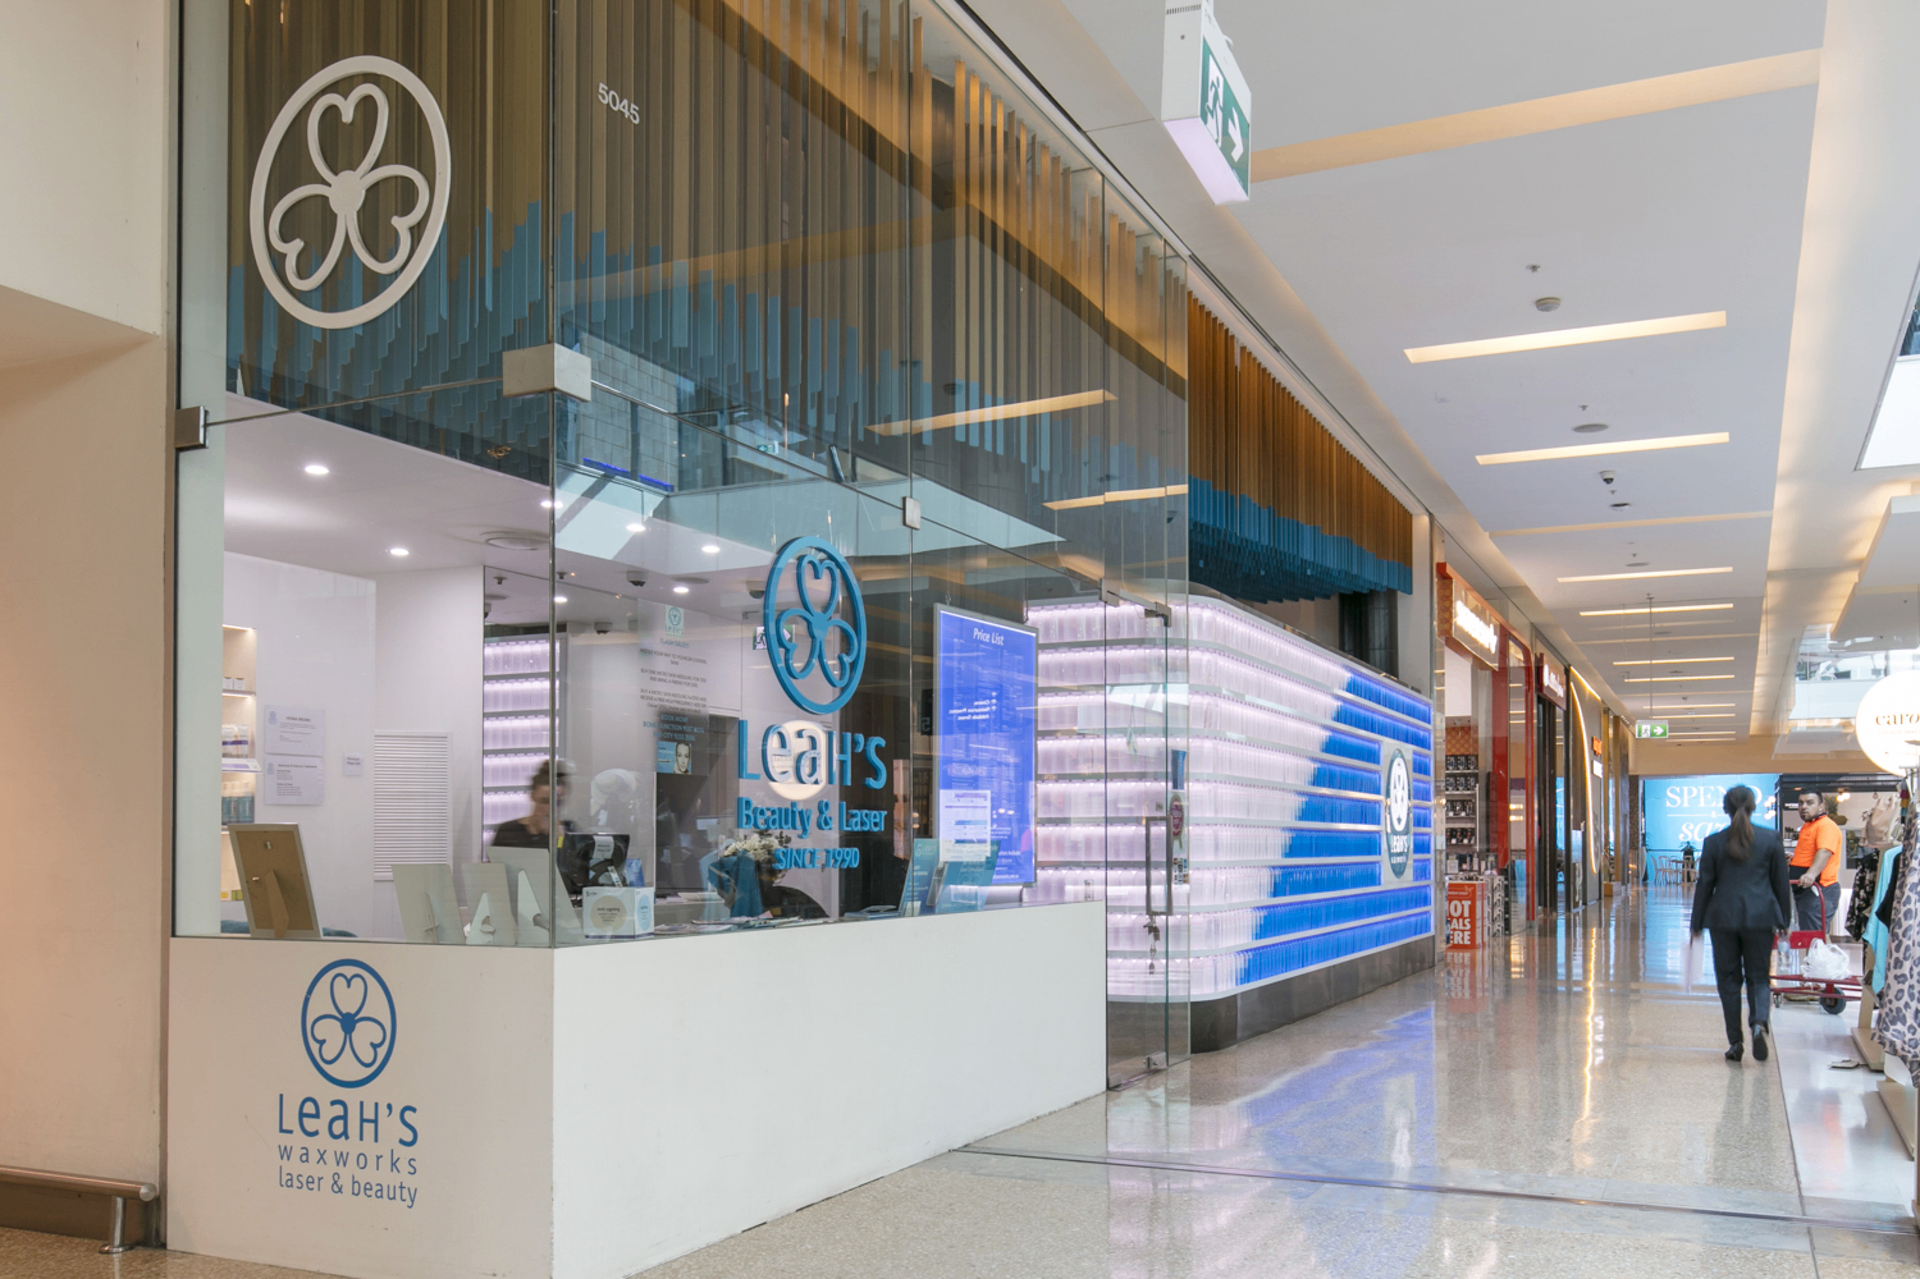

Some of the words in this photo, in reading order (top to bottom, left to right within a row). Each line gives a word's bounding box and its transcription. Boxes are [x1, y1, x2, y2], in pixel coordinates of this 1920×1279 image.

[598, 82, 640, 124] 5045
[973, 628, 990, 643] Price
[992, 632, 1004, 646] List
[737, 797, 813, 839] Beauty
[817, 799, 833, 831] &
[839, 801, 888, 832] Laser
[772, 847, 822, 870] SINCE
[824, 847, 860, 870] 1990
[1448, 899, 1471, 917] OT
[1450, 917, 1471, 931] ALS
[278, 1144, 417, 1175] waxworks
[279, 1165, 324, 1192] laser
[330, 1172, 343, 1195] &
[351, 1174, 418, 1209] beauty
